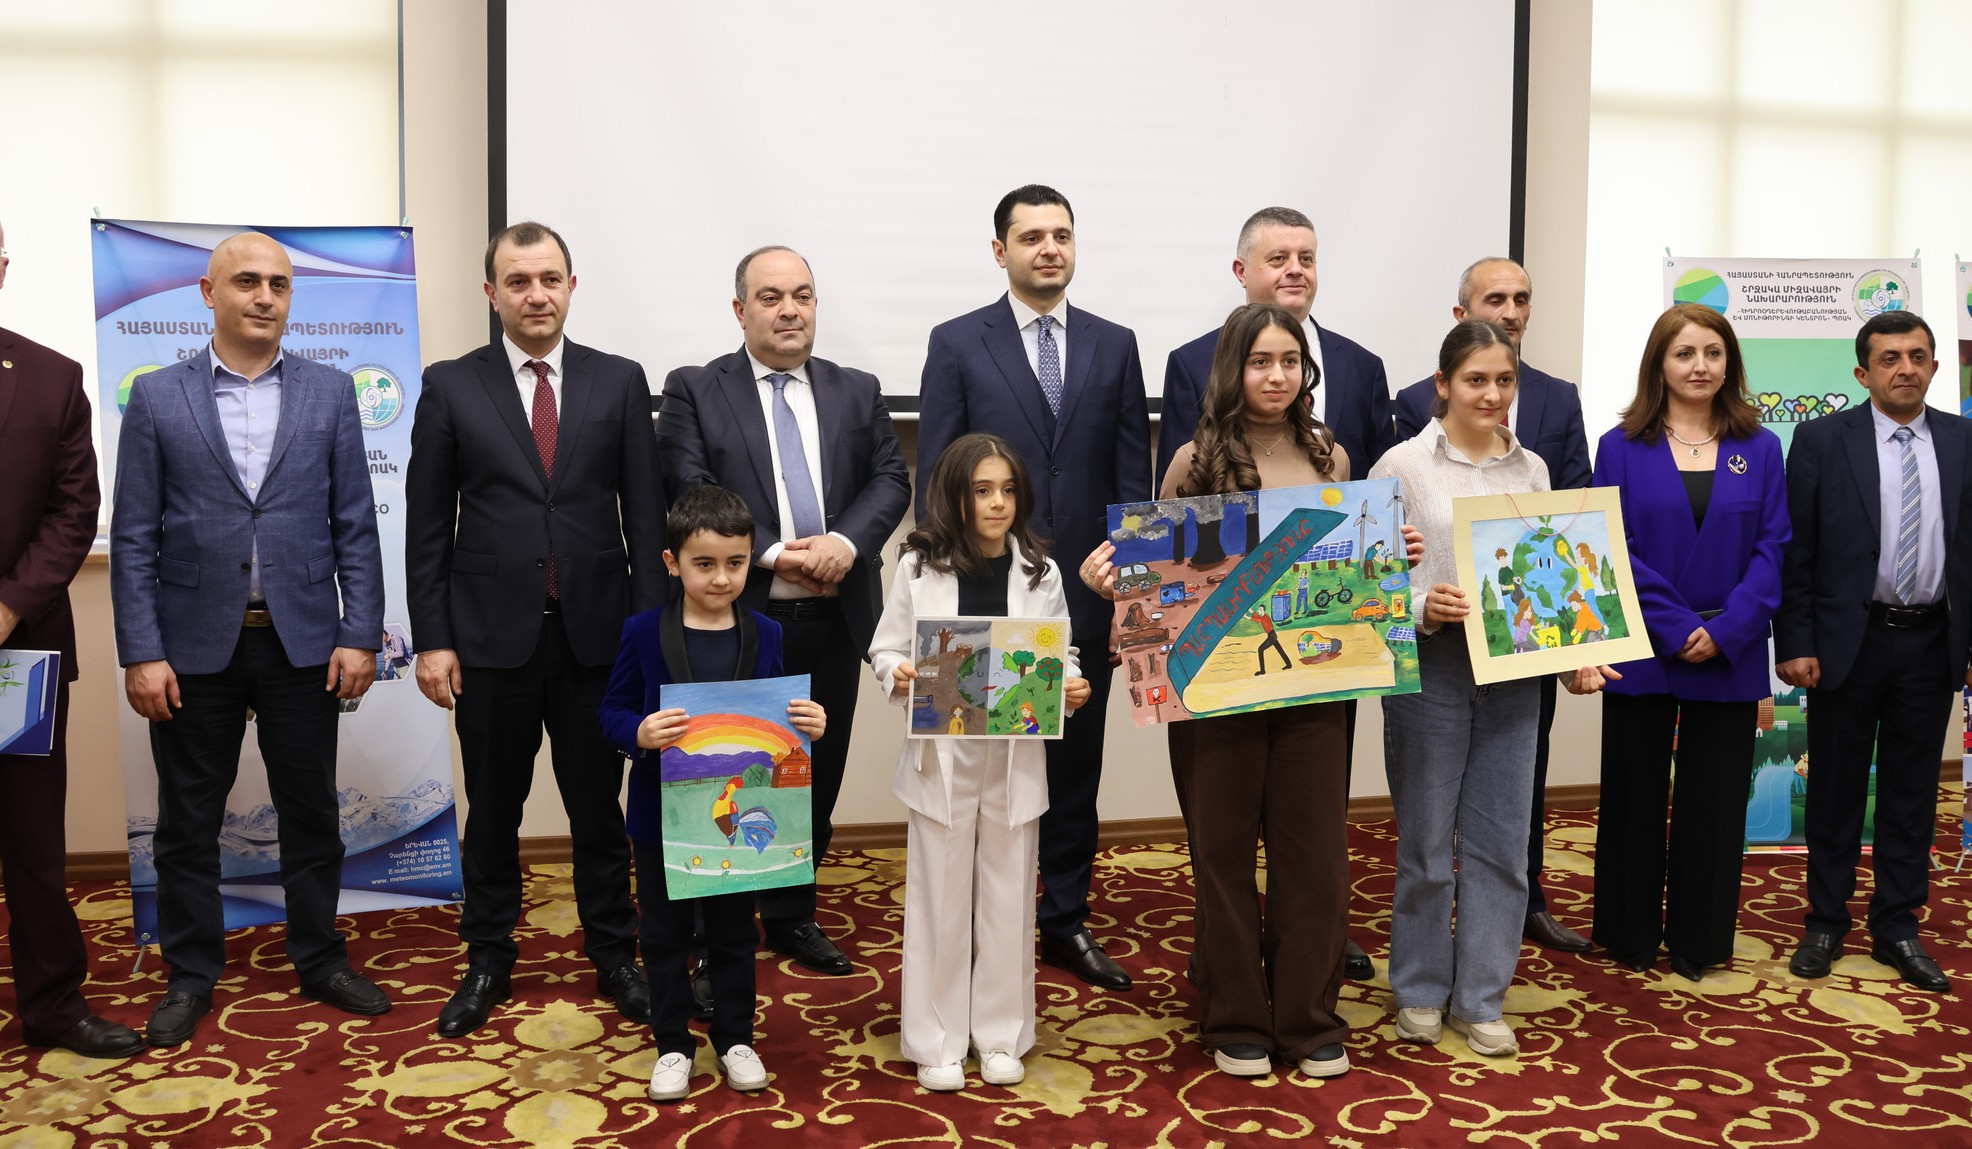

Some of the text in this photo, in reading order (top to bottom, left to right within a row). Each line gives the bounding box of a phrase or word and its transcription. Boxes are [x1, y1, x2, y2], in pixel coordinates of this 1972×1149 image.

[1726, 271, 1855, 279] ՀԱՅԱՍՏԱՆԻ ՀԱՆՐԱՊԵՏՈՒԹՅՈՒՆ
[1741, 285, 1842, 294] ՇՐՋԱԿԱ ՄԻՋԱՎԱՅՐԻ
[1746, 294, 1837, 303] ՆԱԽԱՐԱՐՈՒԹՅՈՒՆ
[116, 320, 215, 336] ՀԱՅԱՍՏԱՆ
[396, 857, 416, 867] (+374)
[388, 866, 409, 875] E-mail:
[389, 870, 453, 883] meteomonitoring.am
